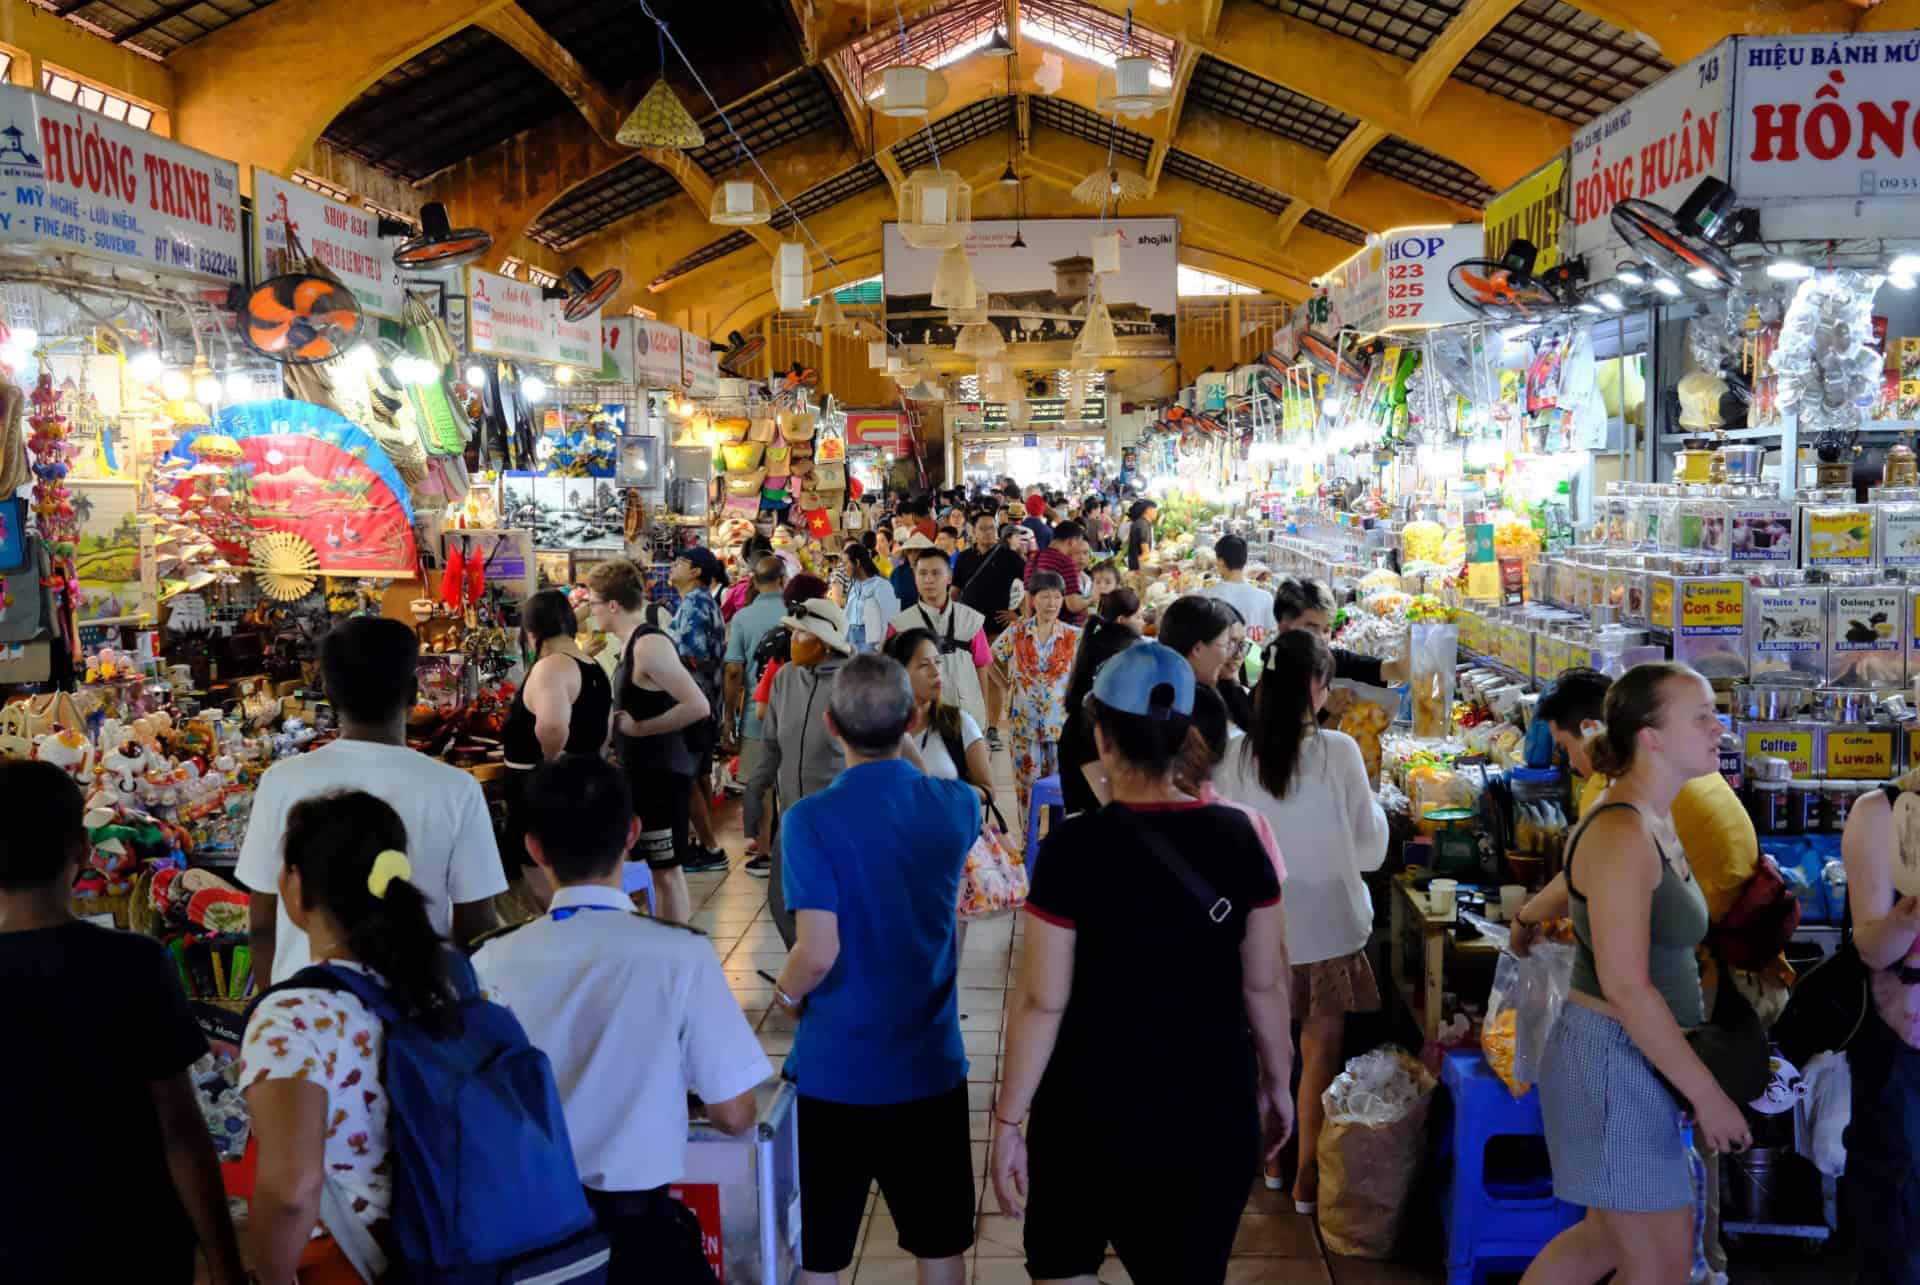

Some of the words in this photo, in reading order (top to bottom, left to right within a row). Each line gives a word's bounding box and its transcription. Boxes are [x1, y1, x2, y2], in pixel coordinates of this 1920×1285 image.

[1748, 43, 1804, 70] HIỆU
[1811, 42, 1878, 65] BÁNH
[1698, 56, 1719, 88] 743
[1750, 69, 1920, 161] HỒN
[41, 113, 136, 204] HƯƠNG
[144, 153, 212, 226] TRINH
[1575, 146, 1634, 225] HỒNG
[1640, 108, 1719, 198] HUÂN
[33, 215, 60, 237] FINE
[62, 221, 86, 244] ARTS
[324, 204, 349, 232] SHOP
[1683, 601, 1711, 615] Con
[1716, 600, 1743, 615] Soc
[1763, 598, 1793, 607] White
[1800, 598, 1817, 606] Tea
[1877, 598, 1896, 607] Tea
[1760, 738, 1798, 753] Coffee
[1834, 752, 1885, 766] Luwak
